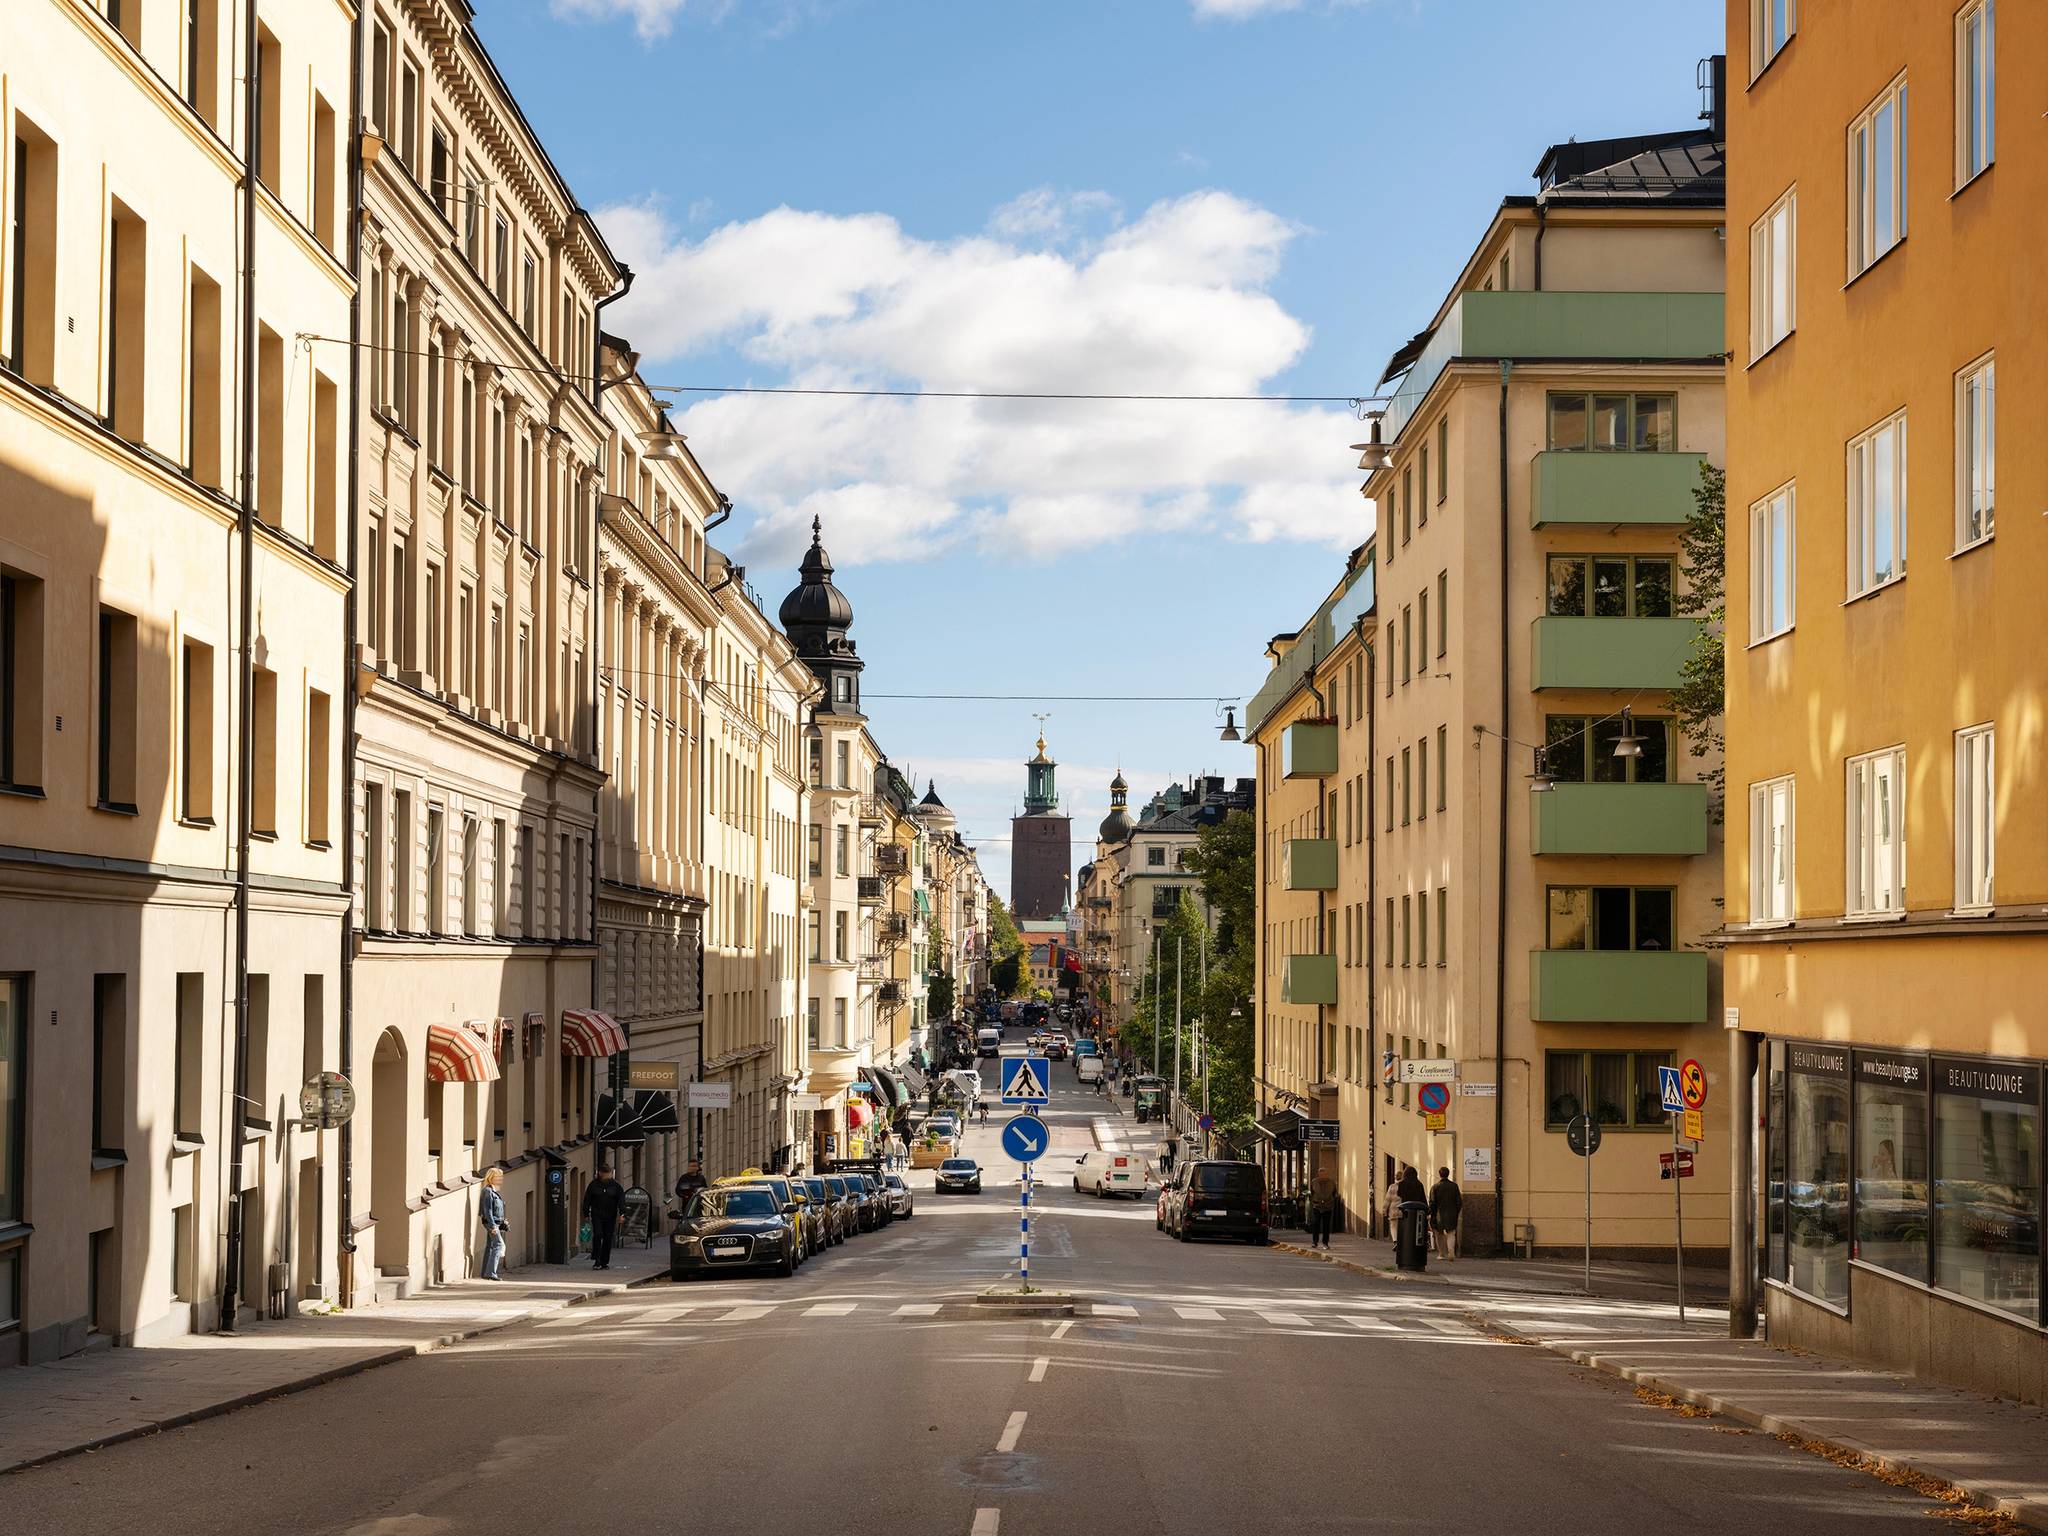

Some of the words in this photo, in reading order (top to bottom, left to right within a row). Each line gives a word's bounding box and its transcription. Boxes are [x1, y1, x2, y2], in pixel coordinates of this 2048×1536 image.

[1794, 1051, 1844, 1072] BEAUTYLOUNGE
[1862, 1058, 1919, 1083] www.beautylounge.se
[631, 1071, 675, 1080] FREEFOOT
[1949, 1069, 2023, 1094] BEAUTYLOUNGE
